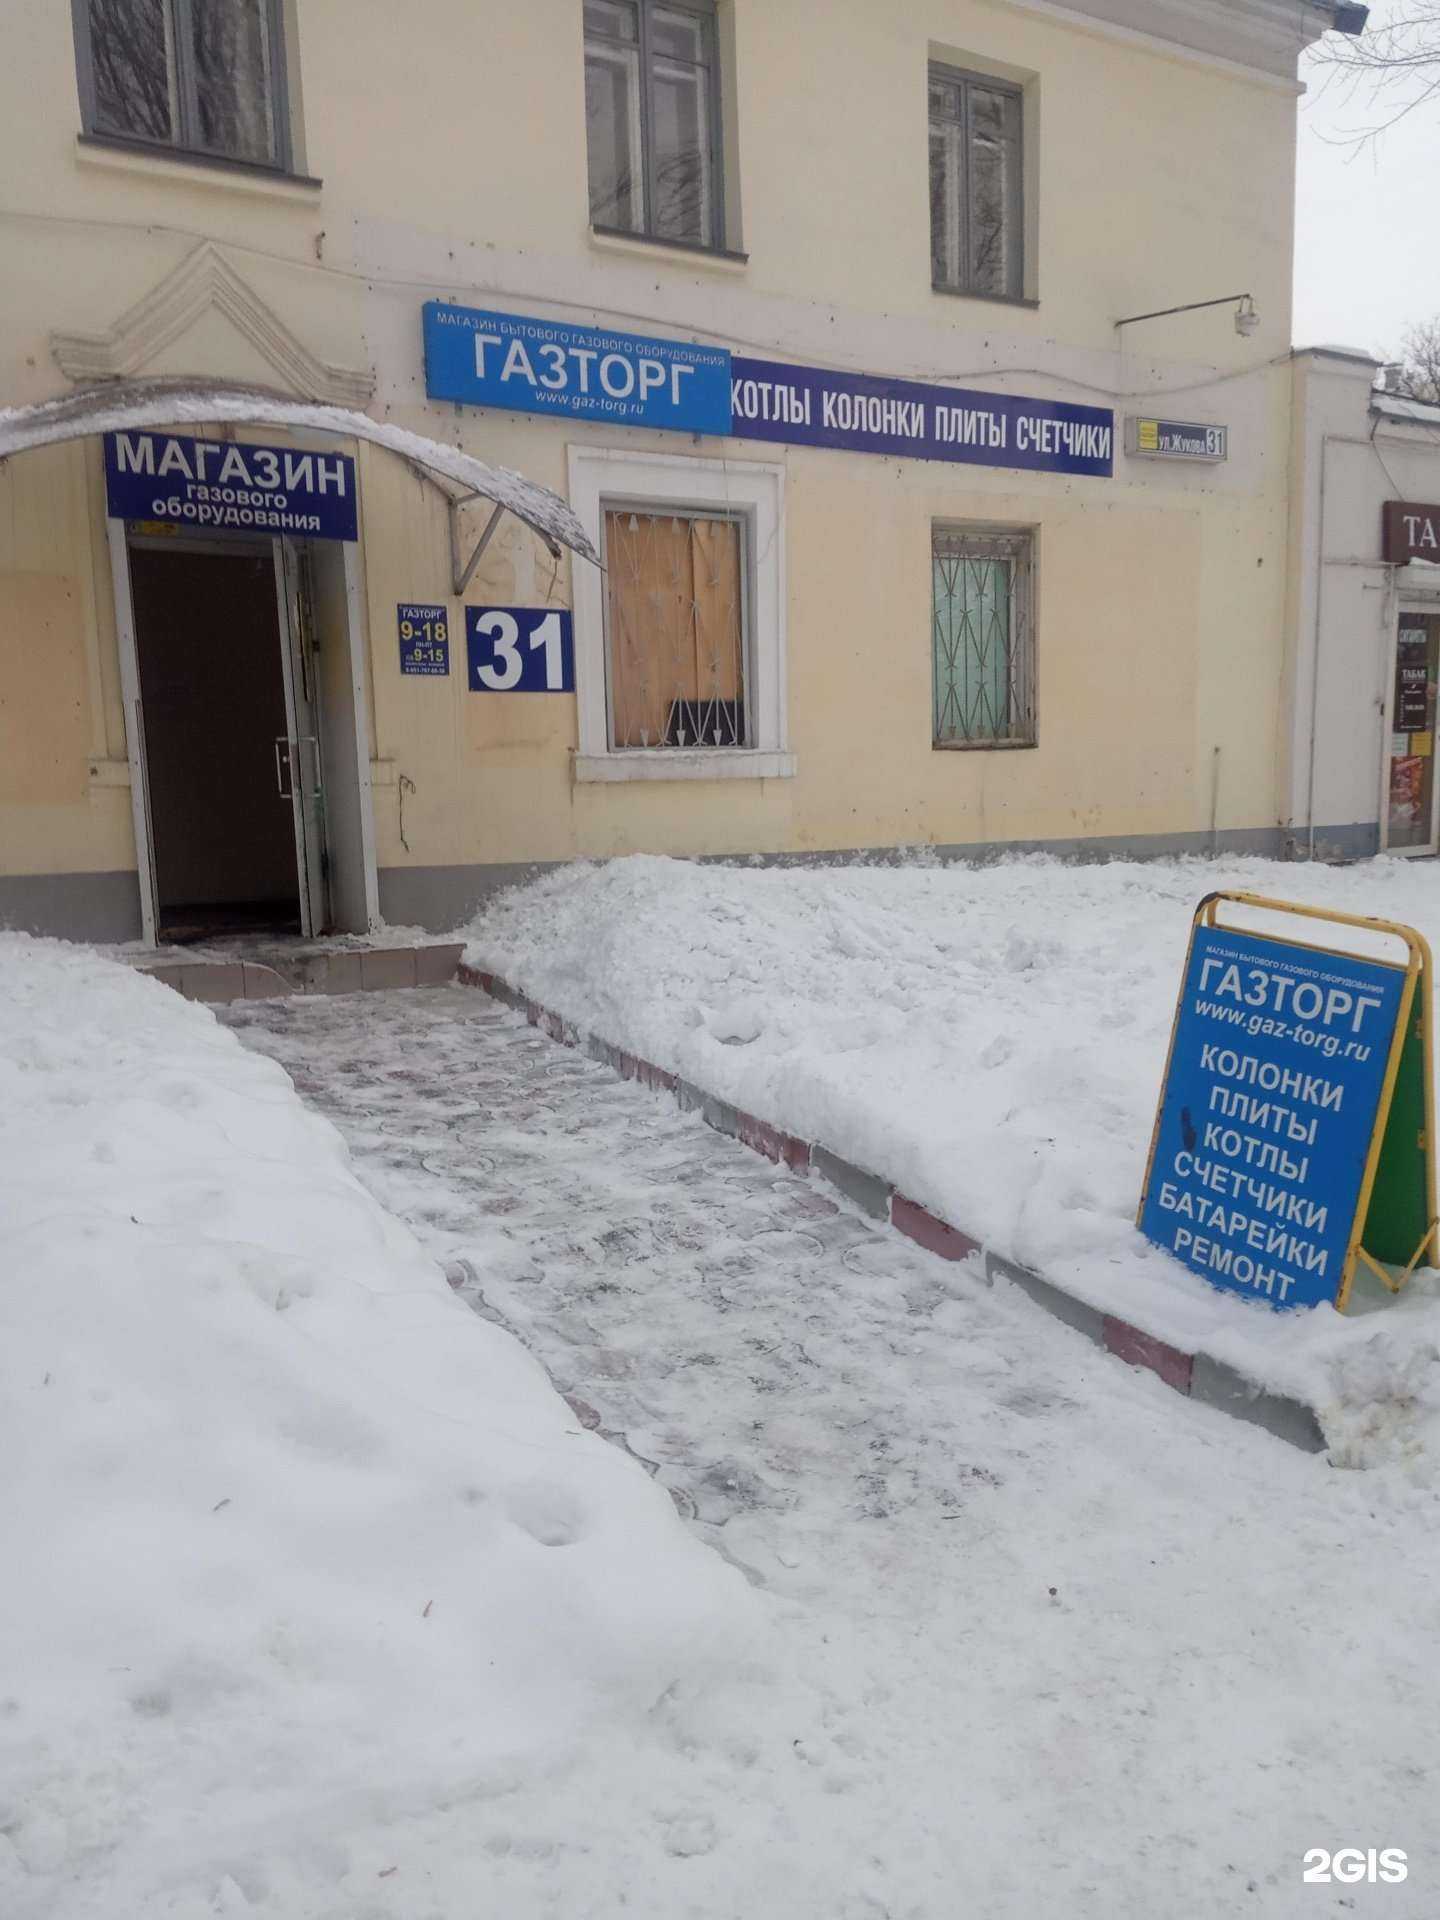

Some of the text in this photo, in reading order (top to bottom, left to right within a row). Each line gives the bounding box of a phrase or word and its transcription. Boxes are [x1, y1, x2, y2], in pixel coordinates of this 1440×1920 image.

[437, 311, 725, 367] МАГАЗИН БЫТОВОГО ГАЗОВОГО ОБОРУДОВАНИЯ
[474, 333, 695, 405] ГАЗТОРГ
[535, 390, 644, 415] www.gaz-torg.ru
[731, 378, 810, 425] КОТЛЫ
[823, 391, 924, 439] КОЛОНКИ
[935, 406, 1006, 447] ПЛИТЫ
[1016, 416, 1111, 459] СЧЕТЧИКИ
[115, 433, 346, 496] МАГАЗИН
[1207, 430, 1223, 454] 31
[152, 496, 321, 531] оборудования
[186, 484, 288, 509] газового
[401, 621, 447, 642] 9-18
[403, 608, 442, 619] ГАЗТОРГ
[414, 648, 444, 662] 9-15
[475, 611, 563, 690] 31
[1198, 958, 1382, 1033] ГАЗТОРГ
[1206, 945, 1384, 994] МАГАЗИН БЫТОВОГО ГАЗОВОГО ОБОРУДОВАНИЯ
[1195, 999, 1372, 1062] www.gaz-torg.ru
[1199, 1043, 1344, 1112] КОЛОНКИ
[1208, 1085, 1318, 1145] ПЛИТЫ
[1203, 1123, 1310, 1183] КОТЛЫ
[1174, 1151, 1328, 1233] СЧЕТЧИКИ
[1158, 1183, 1329, 1276] БАТАРЕЙКИ
[1173, 1228, 1295, 1301] РЕМОНТ
